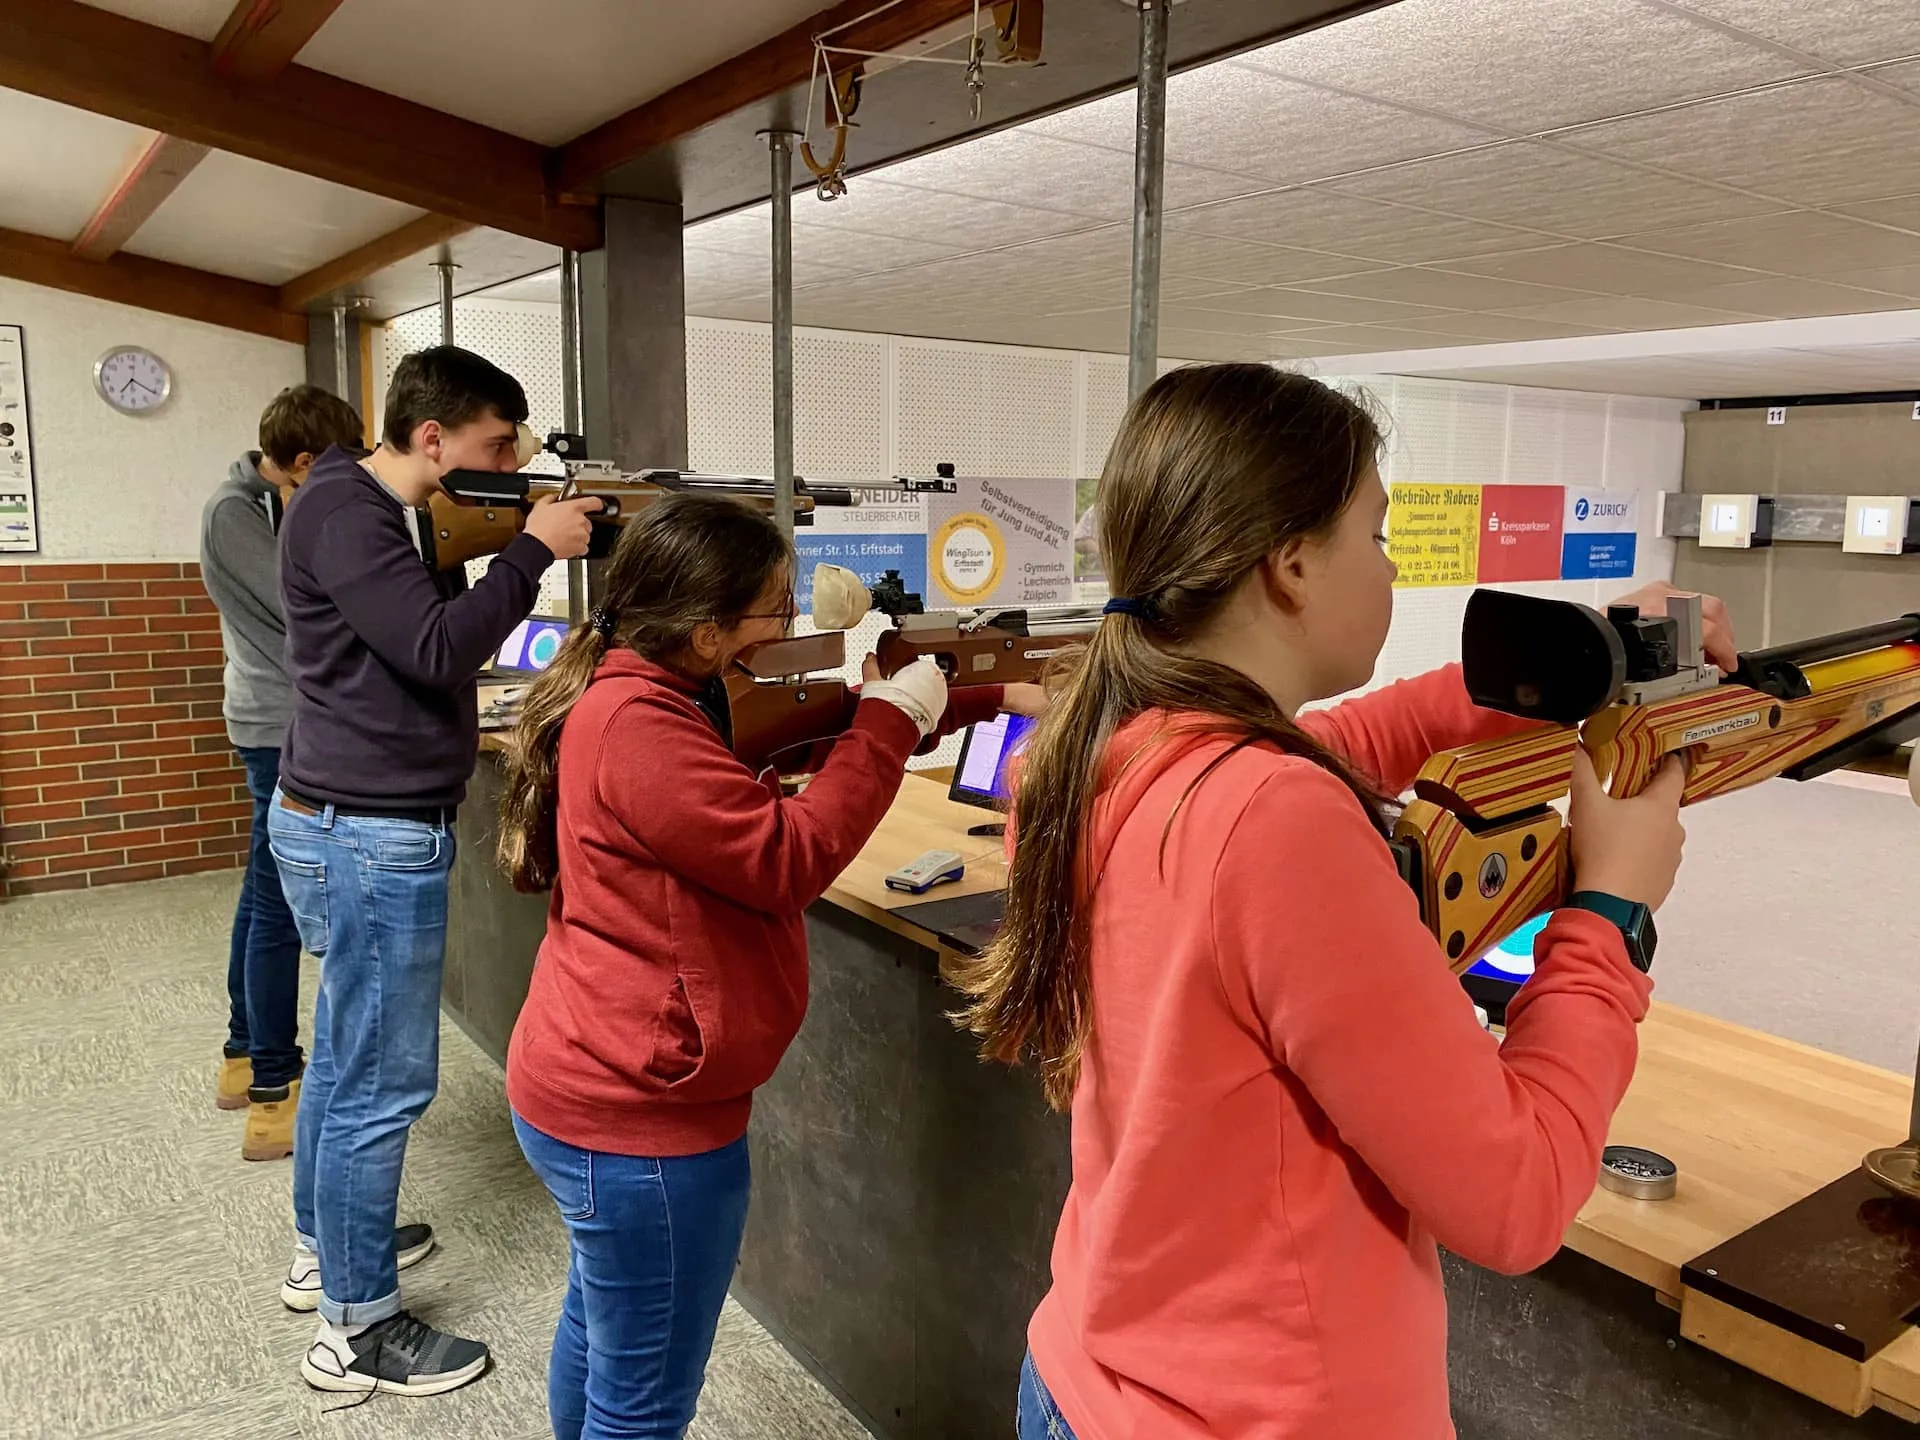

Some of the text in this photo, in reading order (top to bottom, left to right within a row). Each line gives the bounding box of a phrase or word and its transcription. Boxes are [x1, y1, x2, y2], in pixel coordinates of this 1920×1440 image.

[1769, 410, 1782, 421] 11
[857, 489, 920, 503] NEIDER
[1392, 488, 1441, 506] Gebrüder
[980, 480, 1070, 539] Selbstverteidigung
[1593, 503, 1628, 516] ZURICH
[843, 511, 920, 522] STEUERBERATER
[980, 498, 996, 514] für
[997, 510, 1022, 531] Jung
[1024, 523, 1043, 540] und
[1501, 535, 1516, 545] Köln
[824, 544, 842, 556] Str.
[845, 544, 859, 556] 15,
[861, 544, 904, 555] Erftstadt
[1024, 562, 1064, 575] Gymnich
[1024, 576, 1070, 587] Lechenich
[1023, 590, 1058, 601] Zülpich
[1684, 716, 1758, 742] Feinwerkbau
